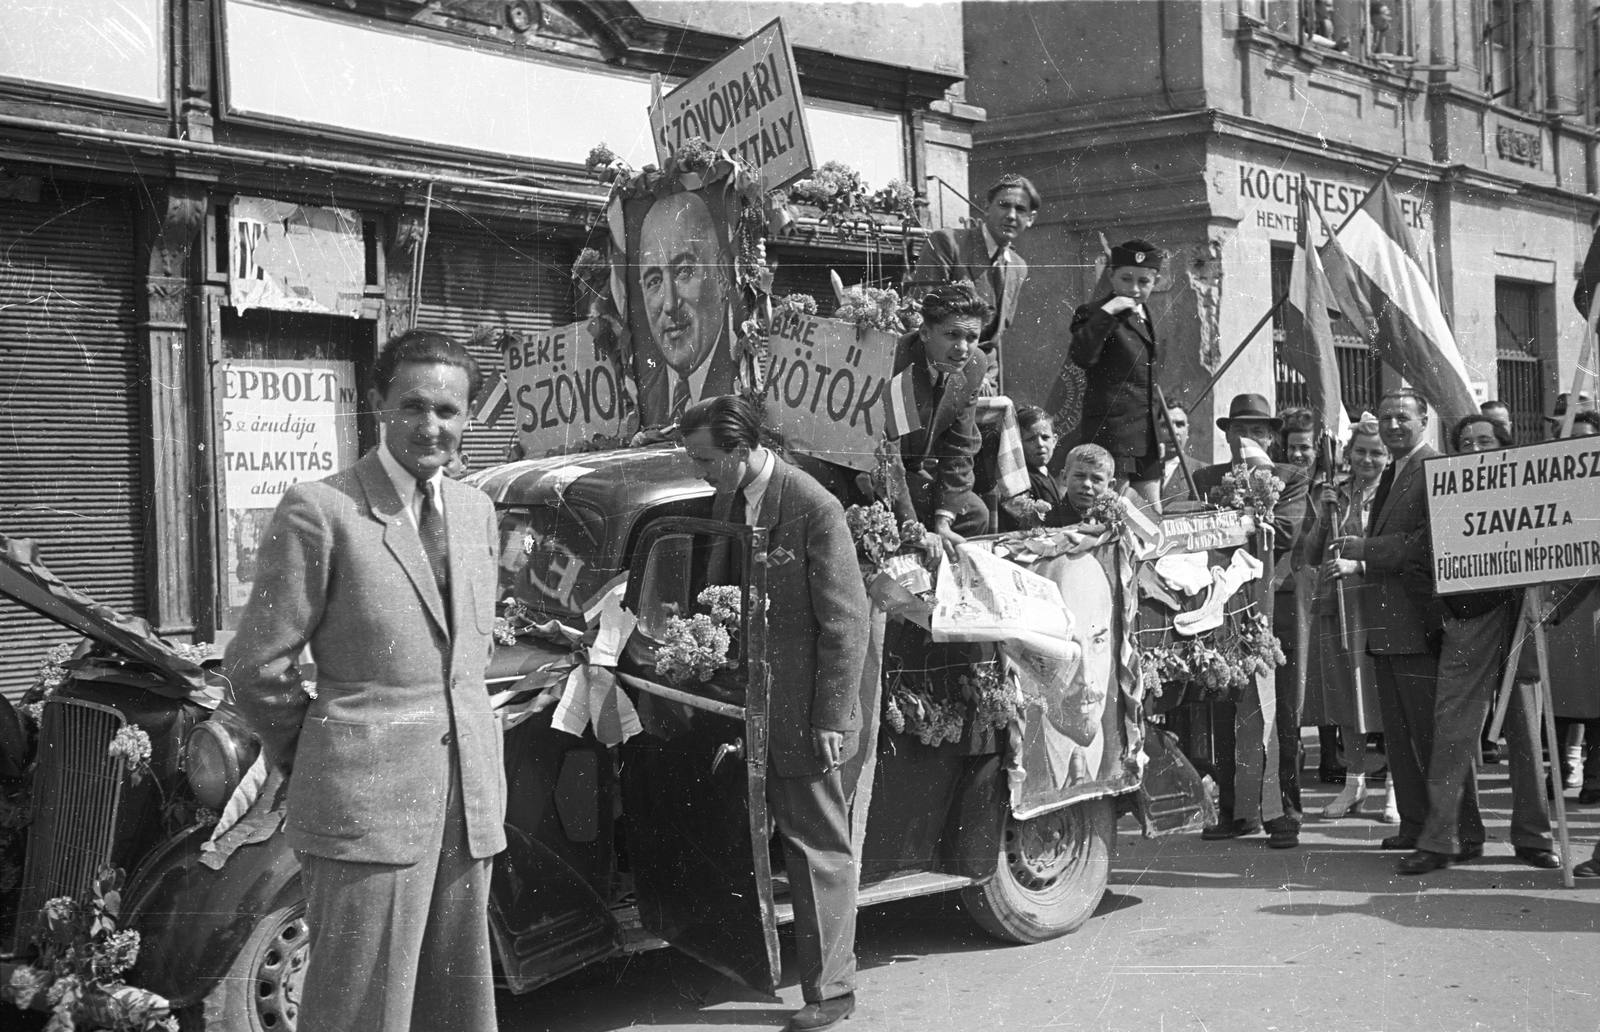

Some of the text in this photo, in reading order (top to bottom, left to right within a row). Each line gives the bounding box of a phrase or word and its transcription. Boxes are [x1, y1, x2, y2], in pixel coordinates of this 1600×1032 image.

[729, 110, 794, 169] SZTÁLY
[1239, 165, 1425, 230] KOCH TESTEK
[1256, 209, 1299, 233] HENTE
[509, 333, 565, 370] BÉKE
[762, 346, 887, 436] KÖTŐK
[251, 413, 316, 440] árudája
[1432, 451, 1600, 497] HA BÉKÉT AKARSZ
[1462, 503, 1573, 537] SZAVAZZ A
[1437, 541, 1522, 581] FÜGGETLENSÉGI
